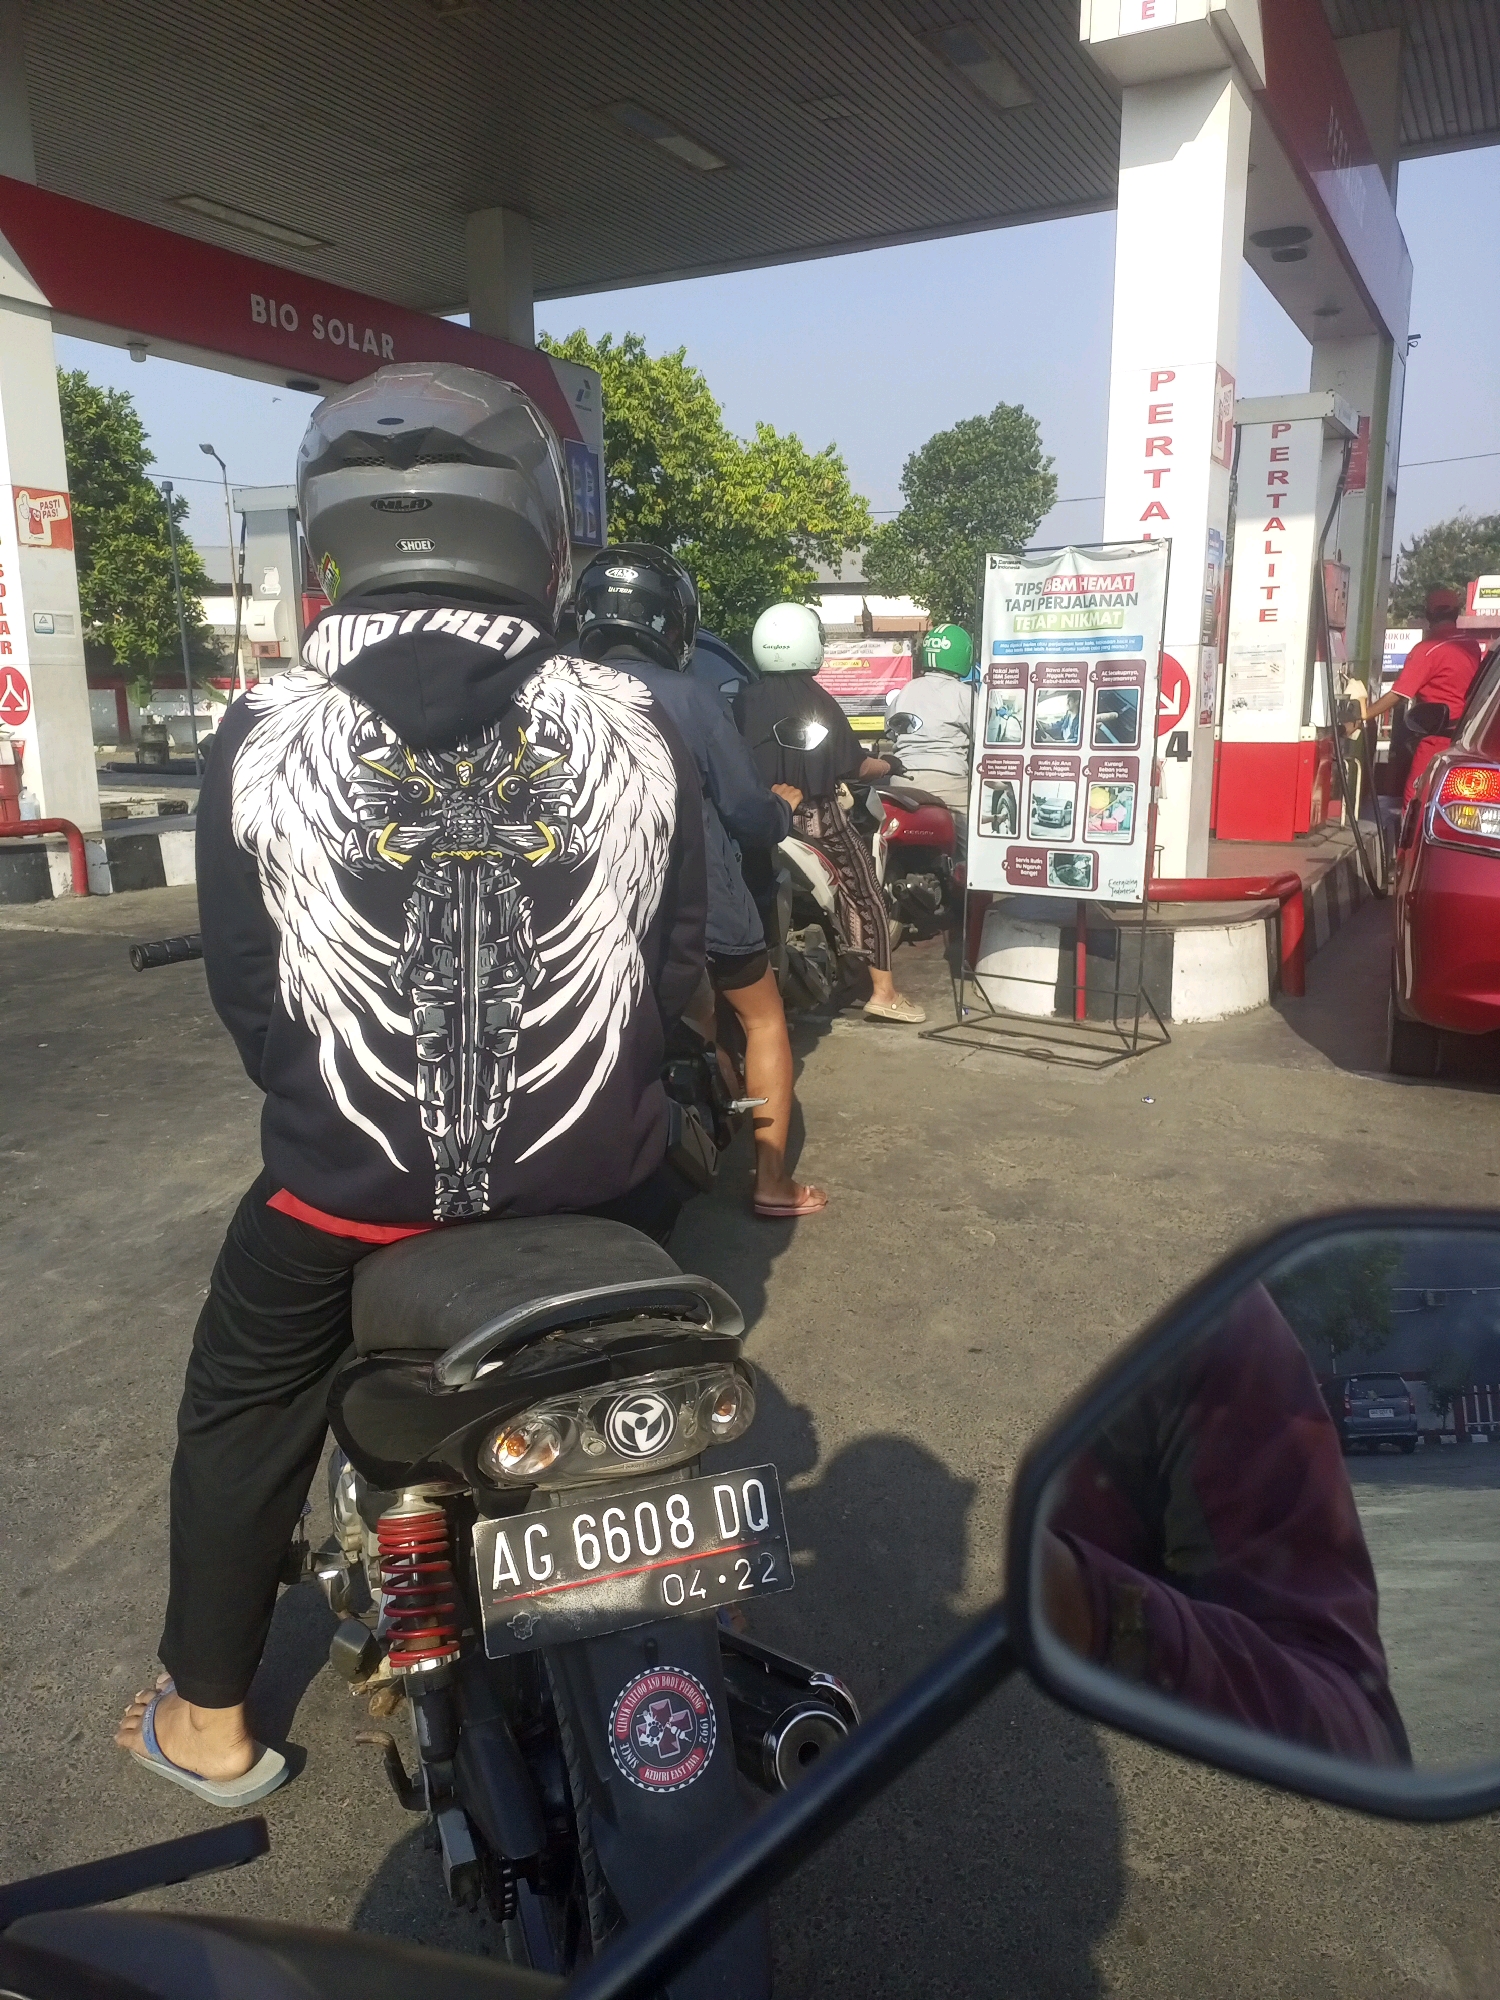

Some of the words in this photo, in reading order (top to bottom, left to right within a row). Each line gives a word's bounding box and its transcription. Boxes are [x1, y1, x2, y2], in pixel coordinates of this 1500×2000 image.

[251, 293, 299, 332] BIO
[312, 313, 395, 361] SOLAR
[39, 498, 61, 511] PASTI
[42, 508, 59, 520] PAS!
[1258, 423, 1291, 623] PERTALITE
[401, 540, 432, 551] SHOEI
[1015, 582, 1043, 596] TIPS
[1044, 576, 1078, 593] BBM
[1078, 574, 1134, 592] HEMAT
[1005, 598, 1035, 612] TAPI
[1037, 592, 1139, 611] PERJALANAN
[1015, 614, 1058, 631] TETAP
[1060, 611, 1122, 630] NIKMAT
[923, 635, 952, 650] Grab
[1165, 731, 1192, 763] 4
[492, 1523, 554, 1591] AG
[573, 1493, 695, 1571] 6608
[713, 1478, 769, 1541] DQ
[624, 1682, 648, 1708] TATTOO
[648, 1676, 661, 1690] AND
[661, 1675, 680, 1688] BODY
[678, 1679, 704, 1710] PIERCING
[698, 1717, 710, 1744] 1992
[620, 1741, 640, 1769] SINCE
[644, 1767, 670, 1782] KEDIRI
[670, 1766, 687, 1781] EAST
[686, 1754, 701, 1772] JAVA
